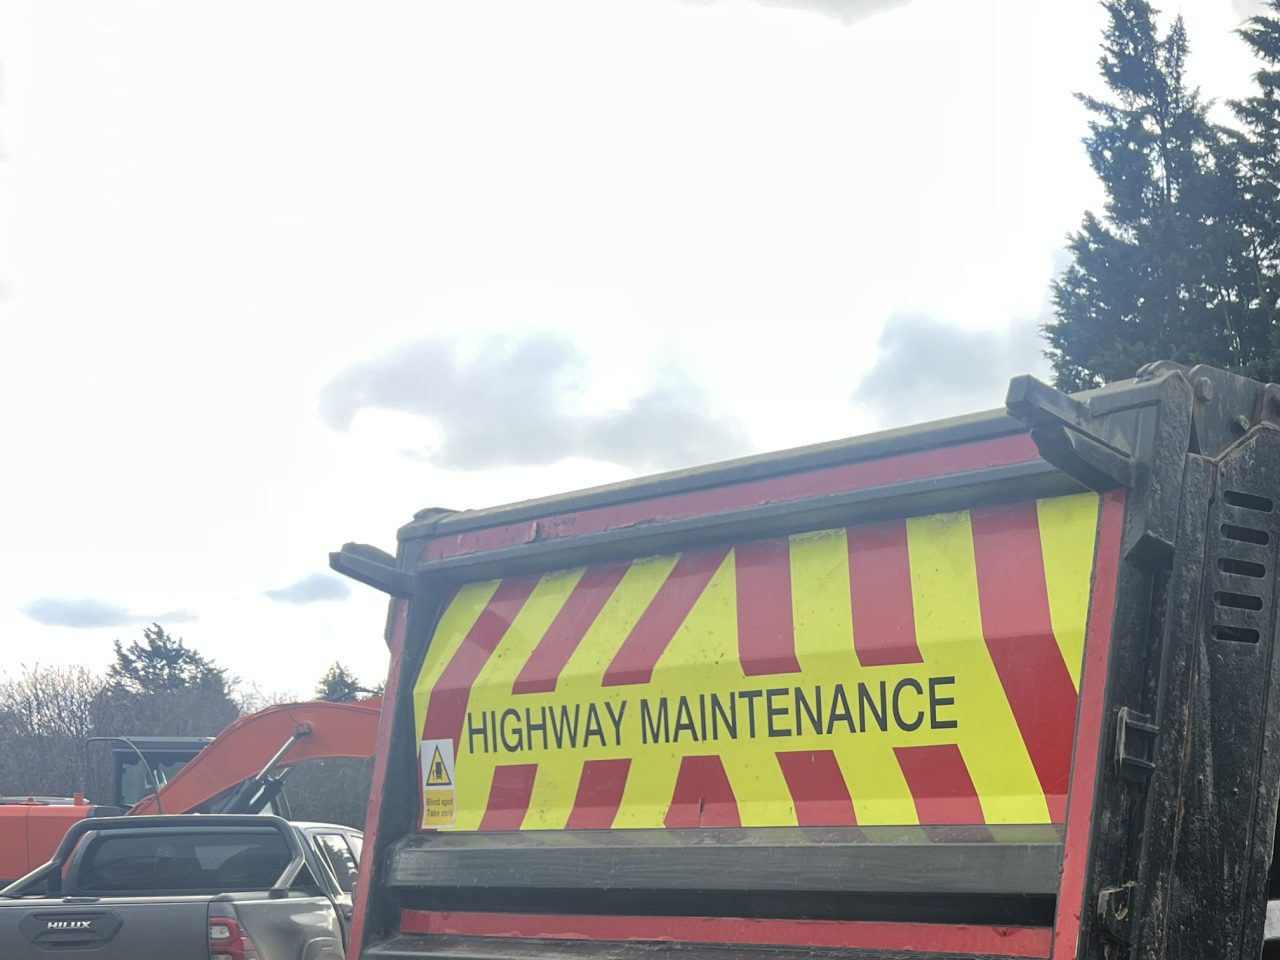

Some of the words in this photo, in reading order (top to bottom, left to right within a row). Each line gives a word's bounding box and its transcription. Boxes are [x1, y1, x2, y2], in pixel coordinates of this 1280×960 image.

[467, 699, 628, 754] HIGHWAY
[641, 676, 958, 745] MAINTENANCE
[426, 797, 440, 806] Blind
[441, 797, 453, 807] spot
[427, 808, 440, 817] Take
[48, 921, 91, 929] HILUX
